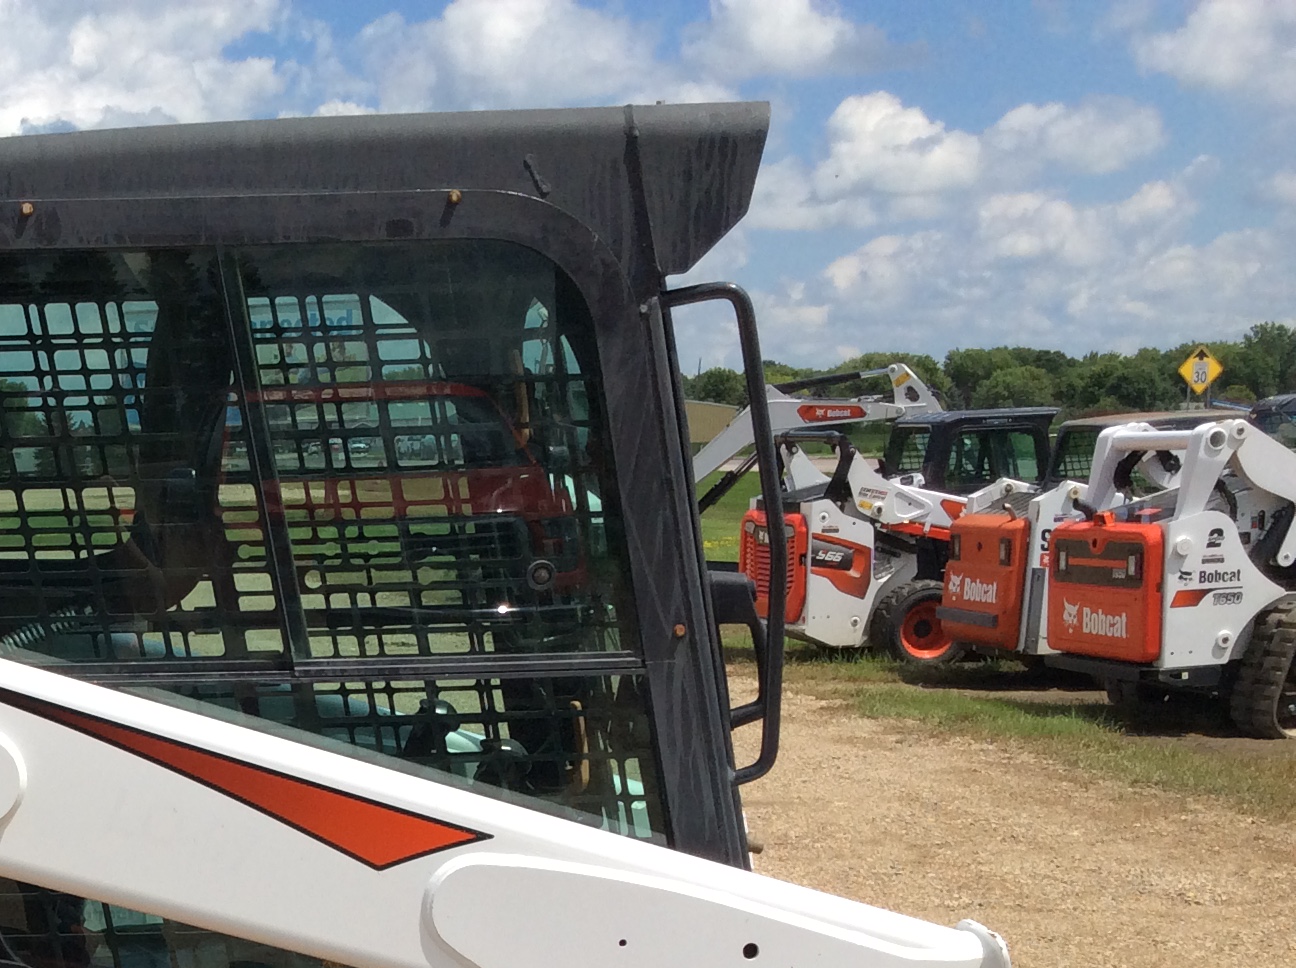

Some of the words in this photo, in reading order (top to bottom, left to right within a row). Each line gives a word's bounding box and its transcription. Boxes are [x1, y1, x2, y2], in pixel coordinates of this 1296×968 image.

[1193, 371, 1207, 384] 30
[826, 408, 851, 418] Bobcat
[1206, 528, 1225, 549] 2
[814, 550, 845, 562] S66
[1199, 569, 1241, 584] Bobcat
[963, 577, 997, 604] Bobcat
[1212, 591, 1243, 606] T650
[1082, 606, 1128, 638] Bobcat
